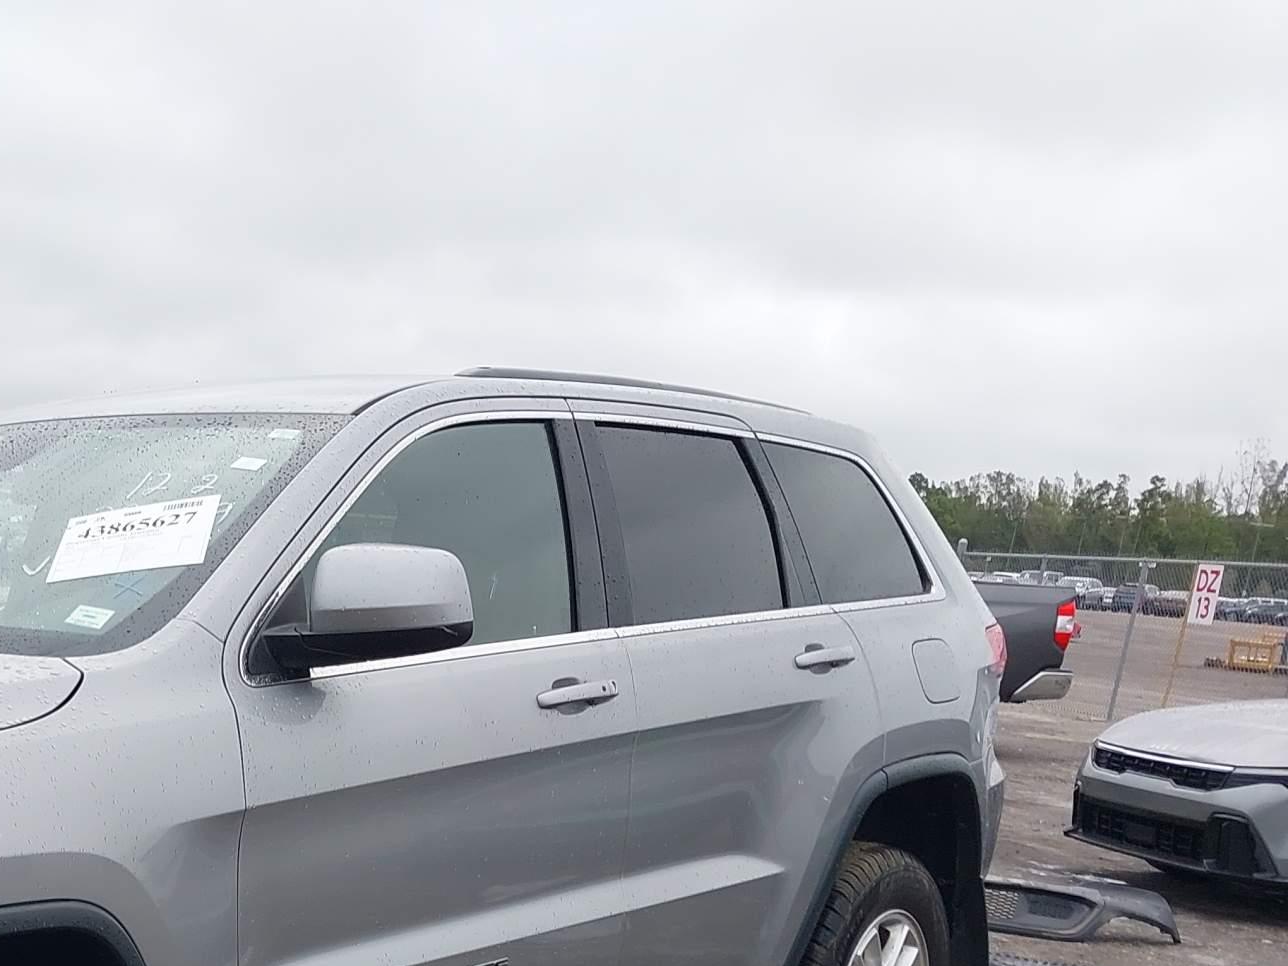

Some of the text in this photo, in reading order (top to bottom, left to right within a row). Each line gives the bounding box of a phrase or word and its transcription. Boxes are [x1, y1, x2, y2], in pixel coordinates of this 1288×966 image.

[77, 511, 198, 539] 43865627
[1197, 569, 1219, 593] DZ
[1196, 596, 1210, 618] 13
